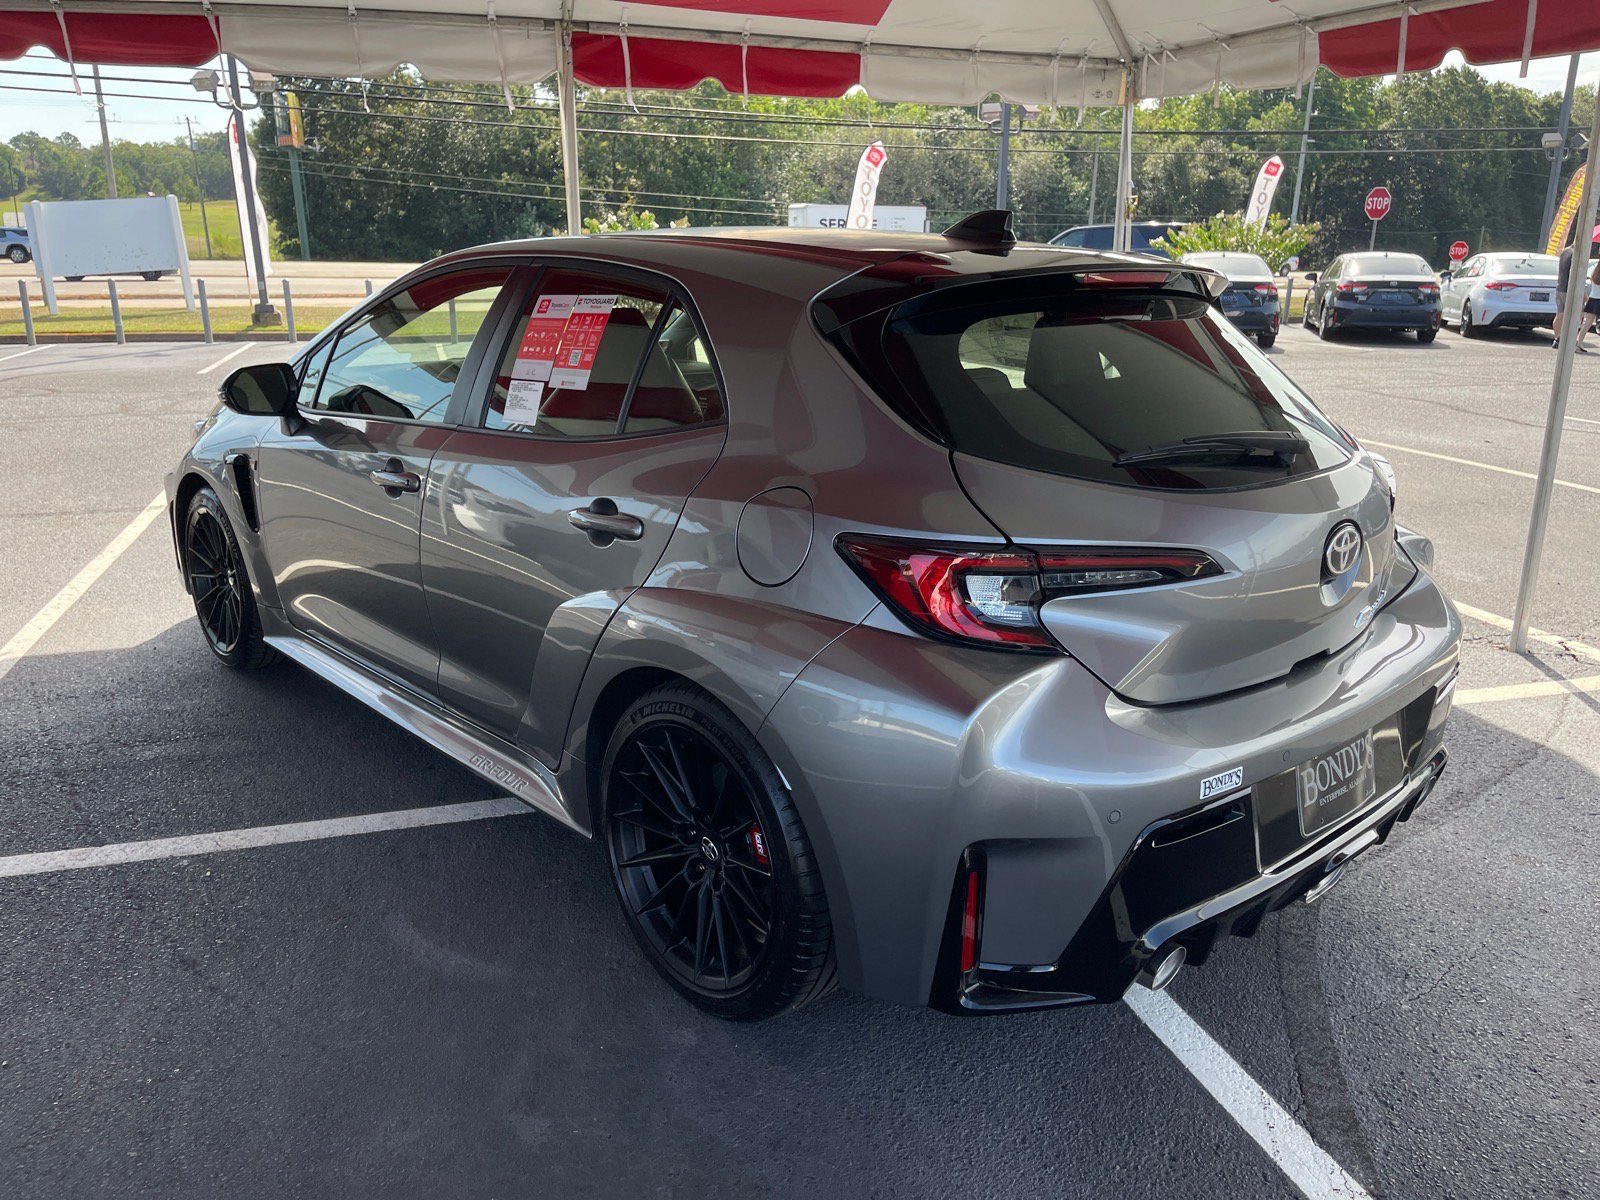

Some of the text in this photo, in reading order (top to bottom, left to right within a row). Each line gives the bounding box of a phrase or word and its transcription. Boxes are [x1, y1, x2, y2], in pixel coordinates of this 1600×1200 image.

[1366, 197, 1390, 210] STOP
[819, 218, 878, 229] SERE
[1450, 247, 1467, 256] STOP
[643, 702, 695, 719] MICHELIN
[1300, 734, 1375, 808] BONDY'S
[1202, 769, 1242, 798] BONDY'S
